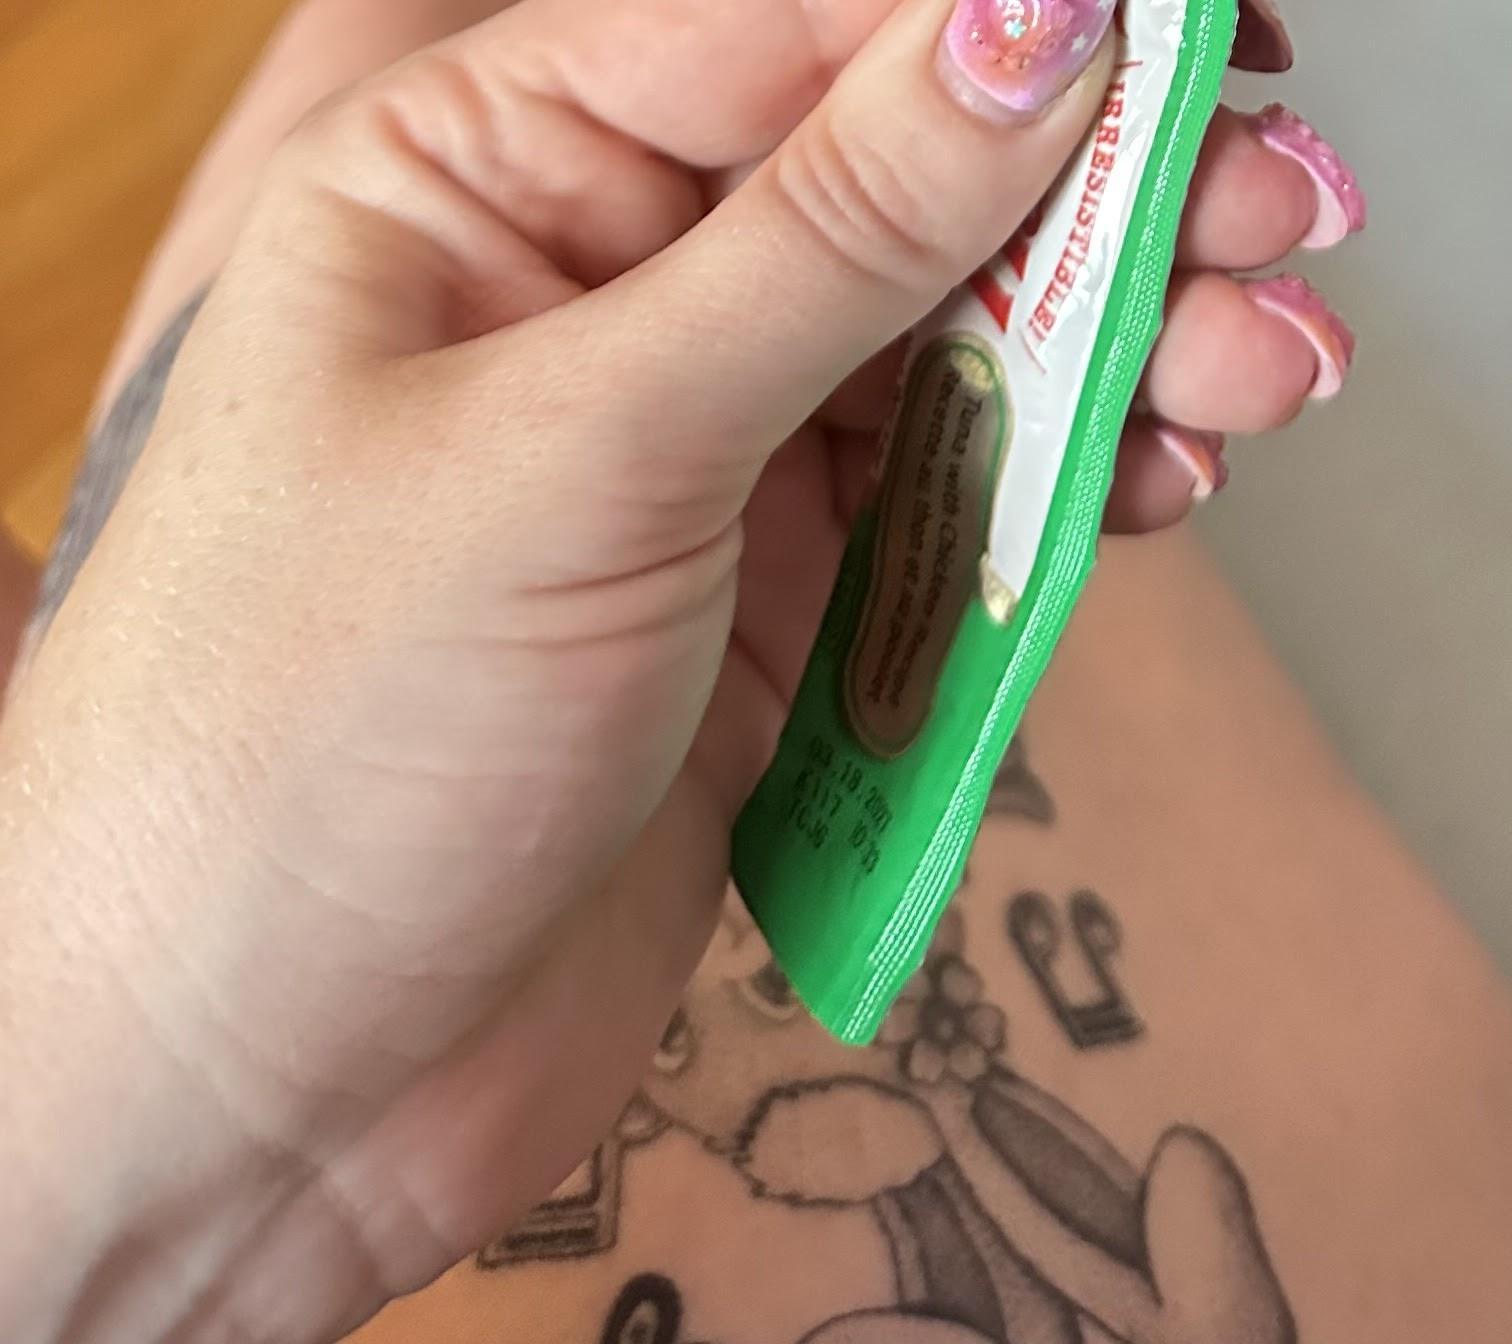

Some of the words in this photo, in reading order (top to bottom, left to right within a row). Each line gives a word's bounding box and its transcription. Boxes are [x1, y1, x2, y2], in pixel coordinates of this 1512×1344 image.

[1028, 79, 1126, 342] IRRESISTIBLE!
[950, 394, 984, 457] Tuna
[943, 462, 963, 518] with
